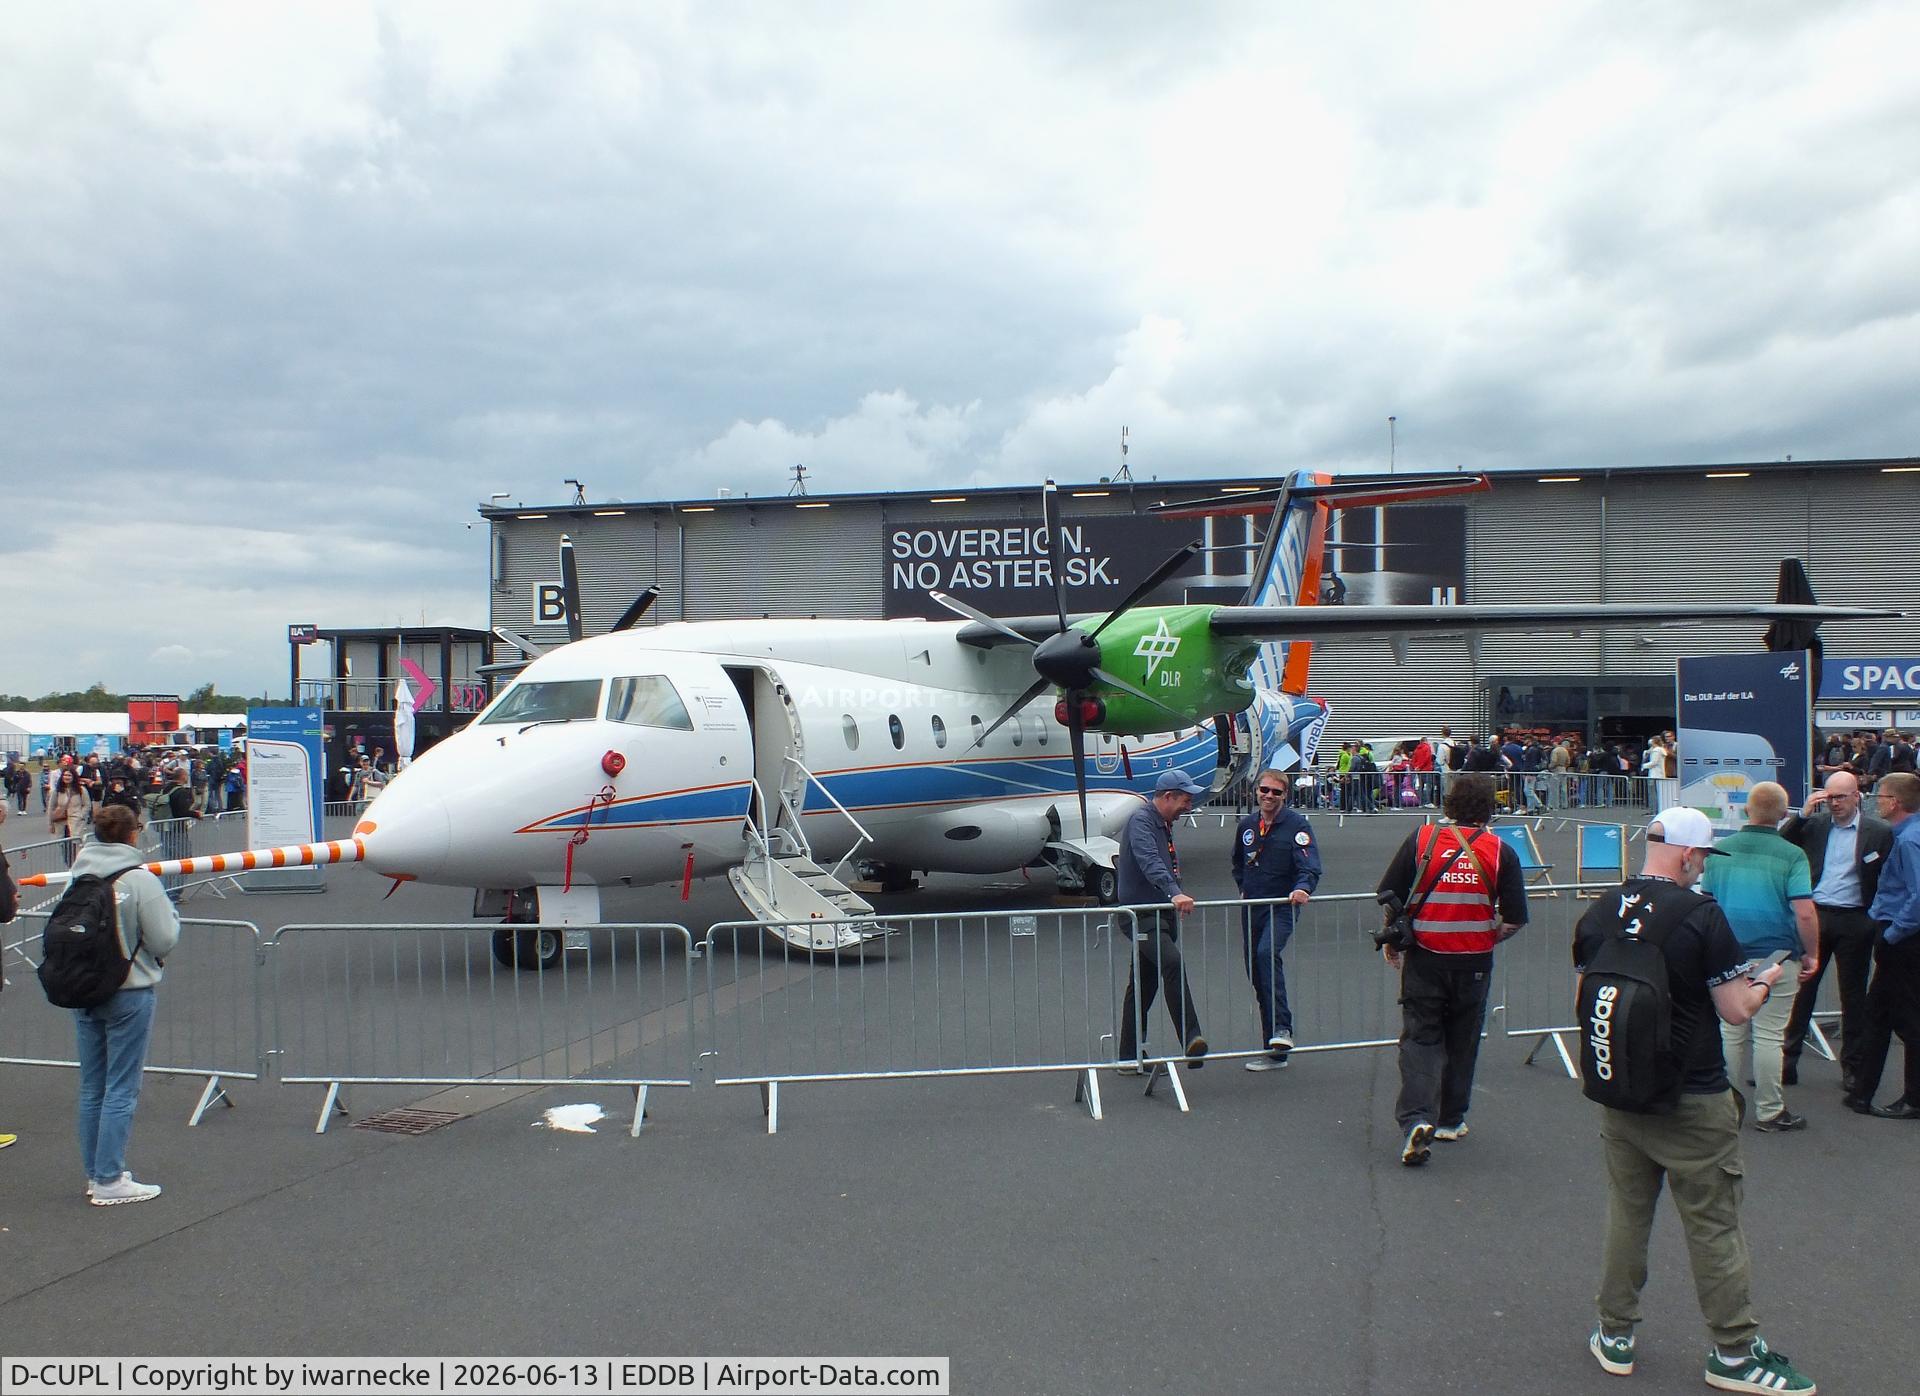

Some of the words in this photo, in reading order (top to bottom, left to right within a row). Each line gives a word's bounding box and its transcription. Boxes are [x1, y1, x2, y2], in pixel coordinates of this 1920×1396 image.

[893, 562, 941, 590] NO
[949, 557, 1120, 589] ASTERSK.
[540, 585, 565, 620] B
[1161, 670, 1181, 687] DLR
[1684, 693, 1698, 701] Das
[1699, 693, 1713, 701] DLR
[1713, 692, 1726, 701] auf
[1727, 692, 1740, 700] der
[1441, 872, 1479, 885] RESSE
[1590, 985, 1617, 1080] adidas
